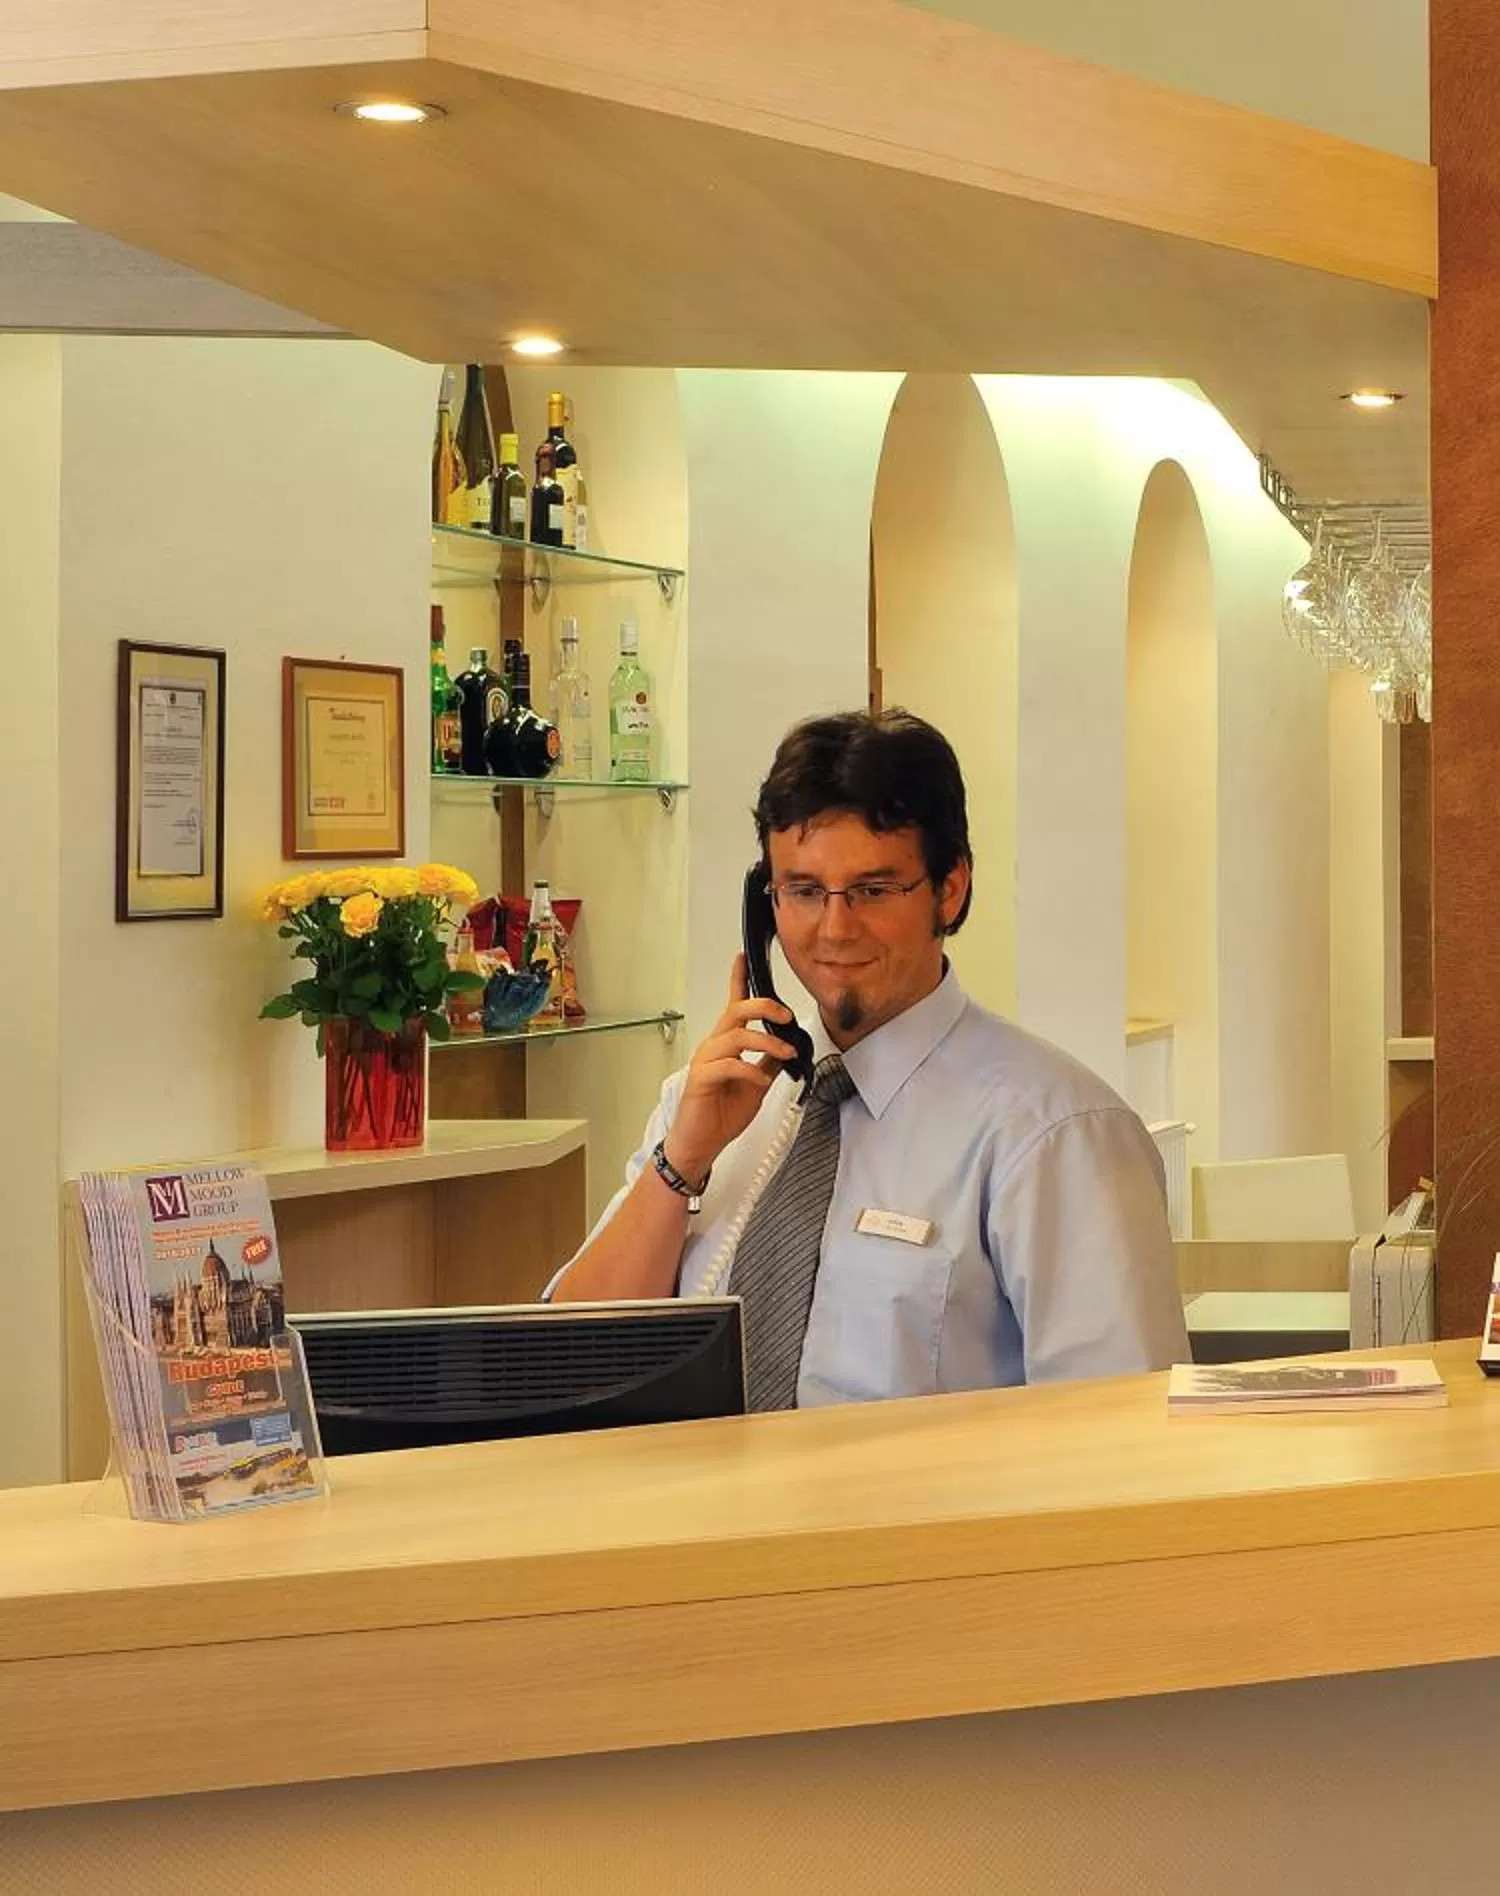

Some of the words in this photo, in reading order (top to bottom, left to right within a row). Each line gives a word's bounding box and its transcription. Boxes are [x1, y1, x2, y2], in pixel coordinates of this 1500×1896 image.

[188, 1185, 234, 1202] MOOD
[192, 1200, 239, 1217] GROUP
[167, 1352, 279, 1385] Budapest
